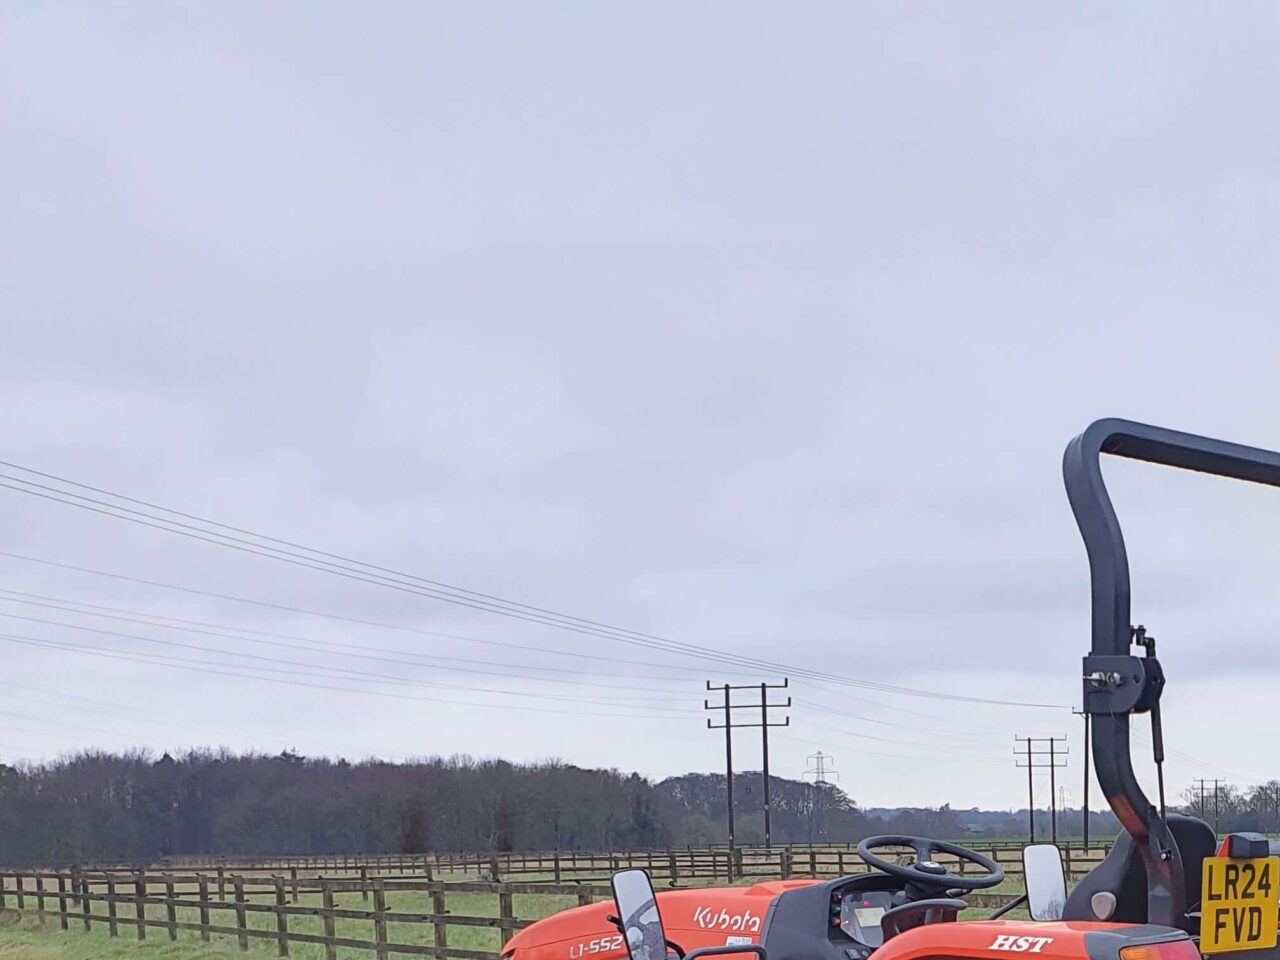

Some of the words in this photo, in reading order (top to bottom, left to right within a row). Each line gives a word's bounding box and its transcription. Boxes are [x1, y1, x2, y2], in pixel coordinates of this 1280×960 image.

[1206, 863, 1271, 901] LR24
[694, 906, 760, 932] Kubota
[1215, 905, 1262, 945] FVD
[988, 934, 1053, 954] HST
